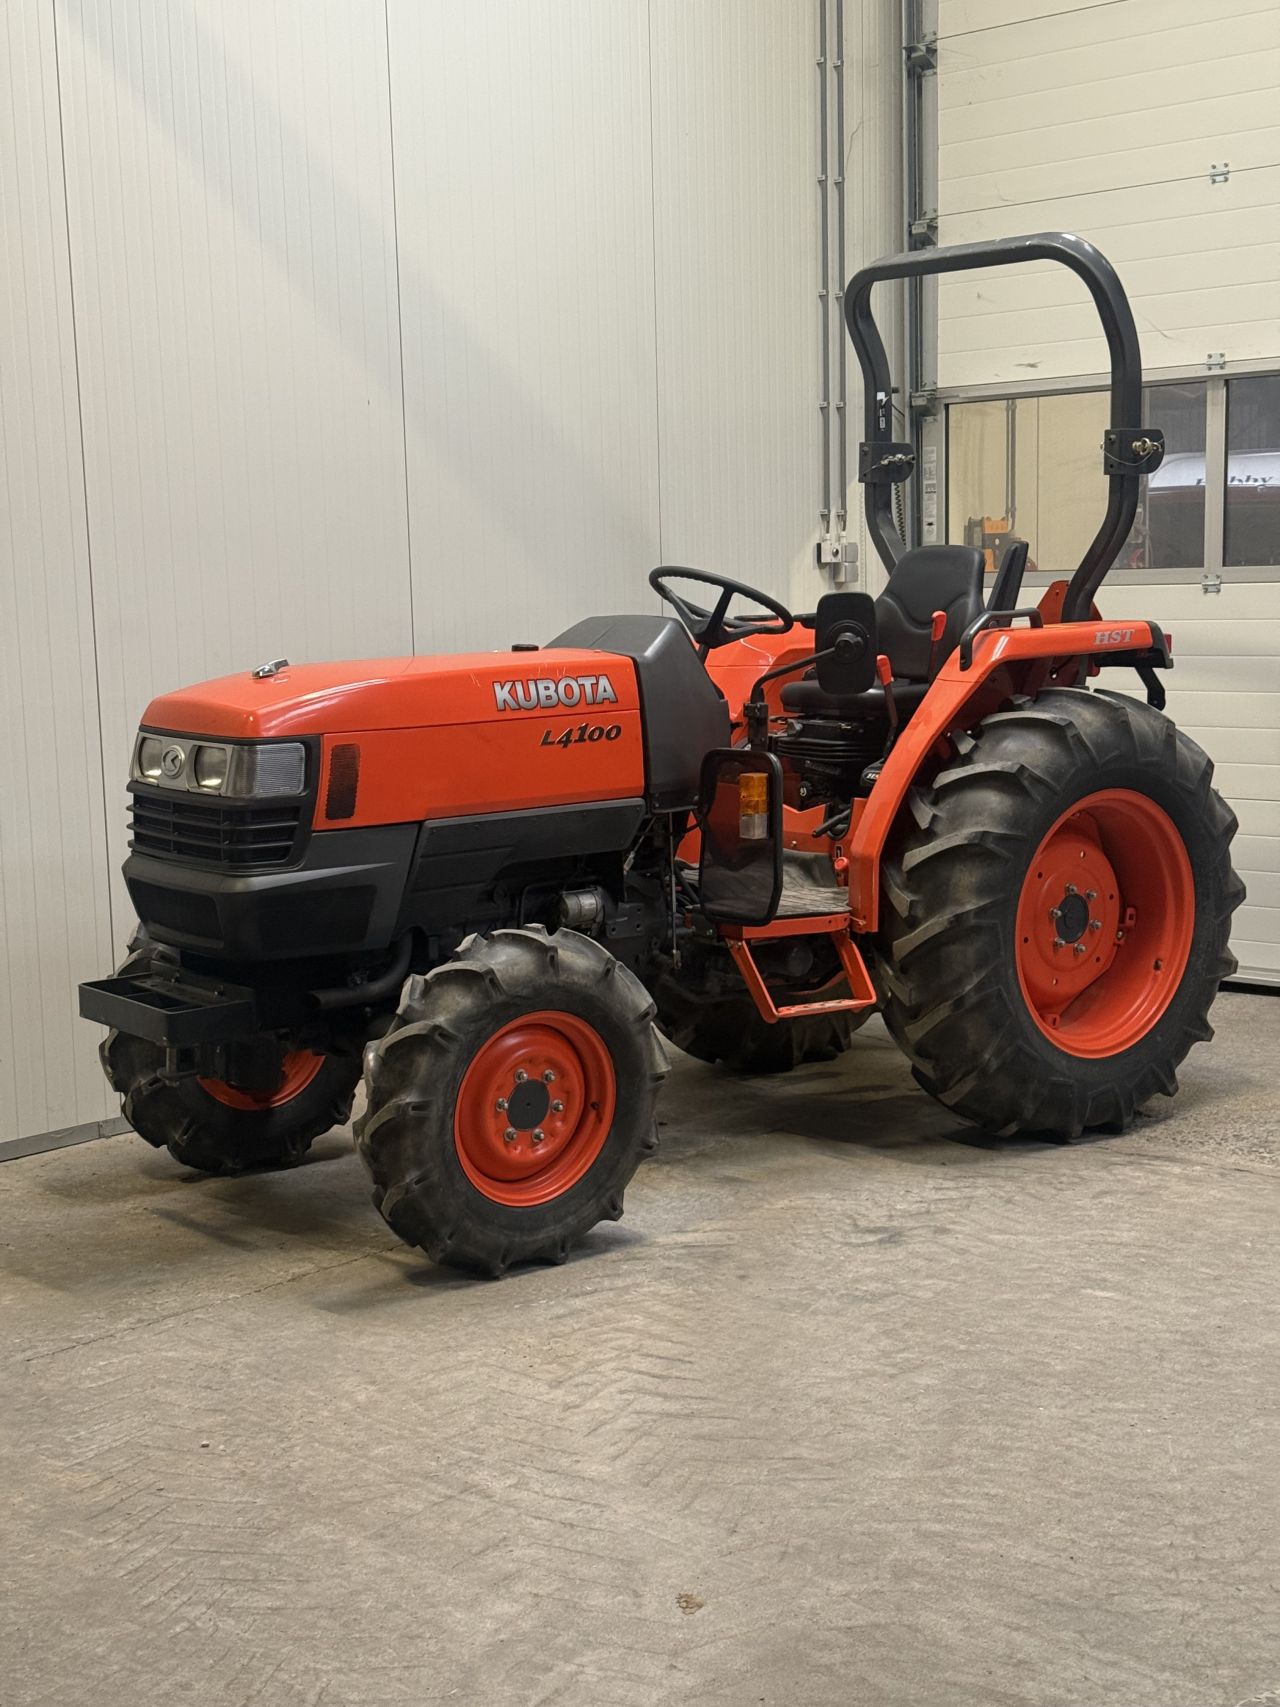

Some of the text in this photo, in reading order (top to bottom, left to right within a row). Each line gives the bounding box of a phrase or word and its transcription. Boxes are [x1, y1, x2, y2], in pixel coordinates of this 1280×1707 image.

[1196, 474, 1273, 485] bby
[1094, 629, 1135, 645] HST
[493, 674, 618, 711] KUBOTA
[539, 722, 622, 749] L4100
